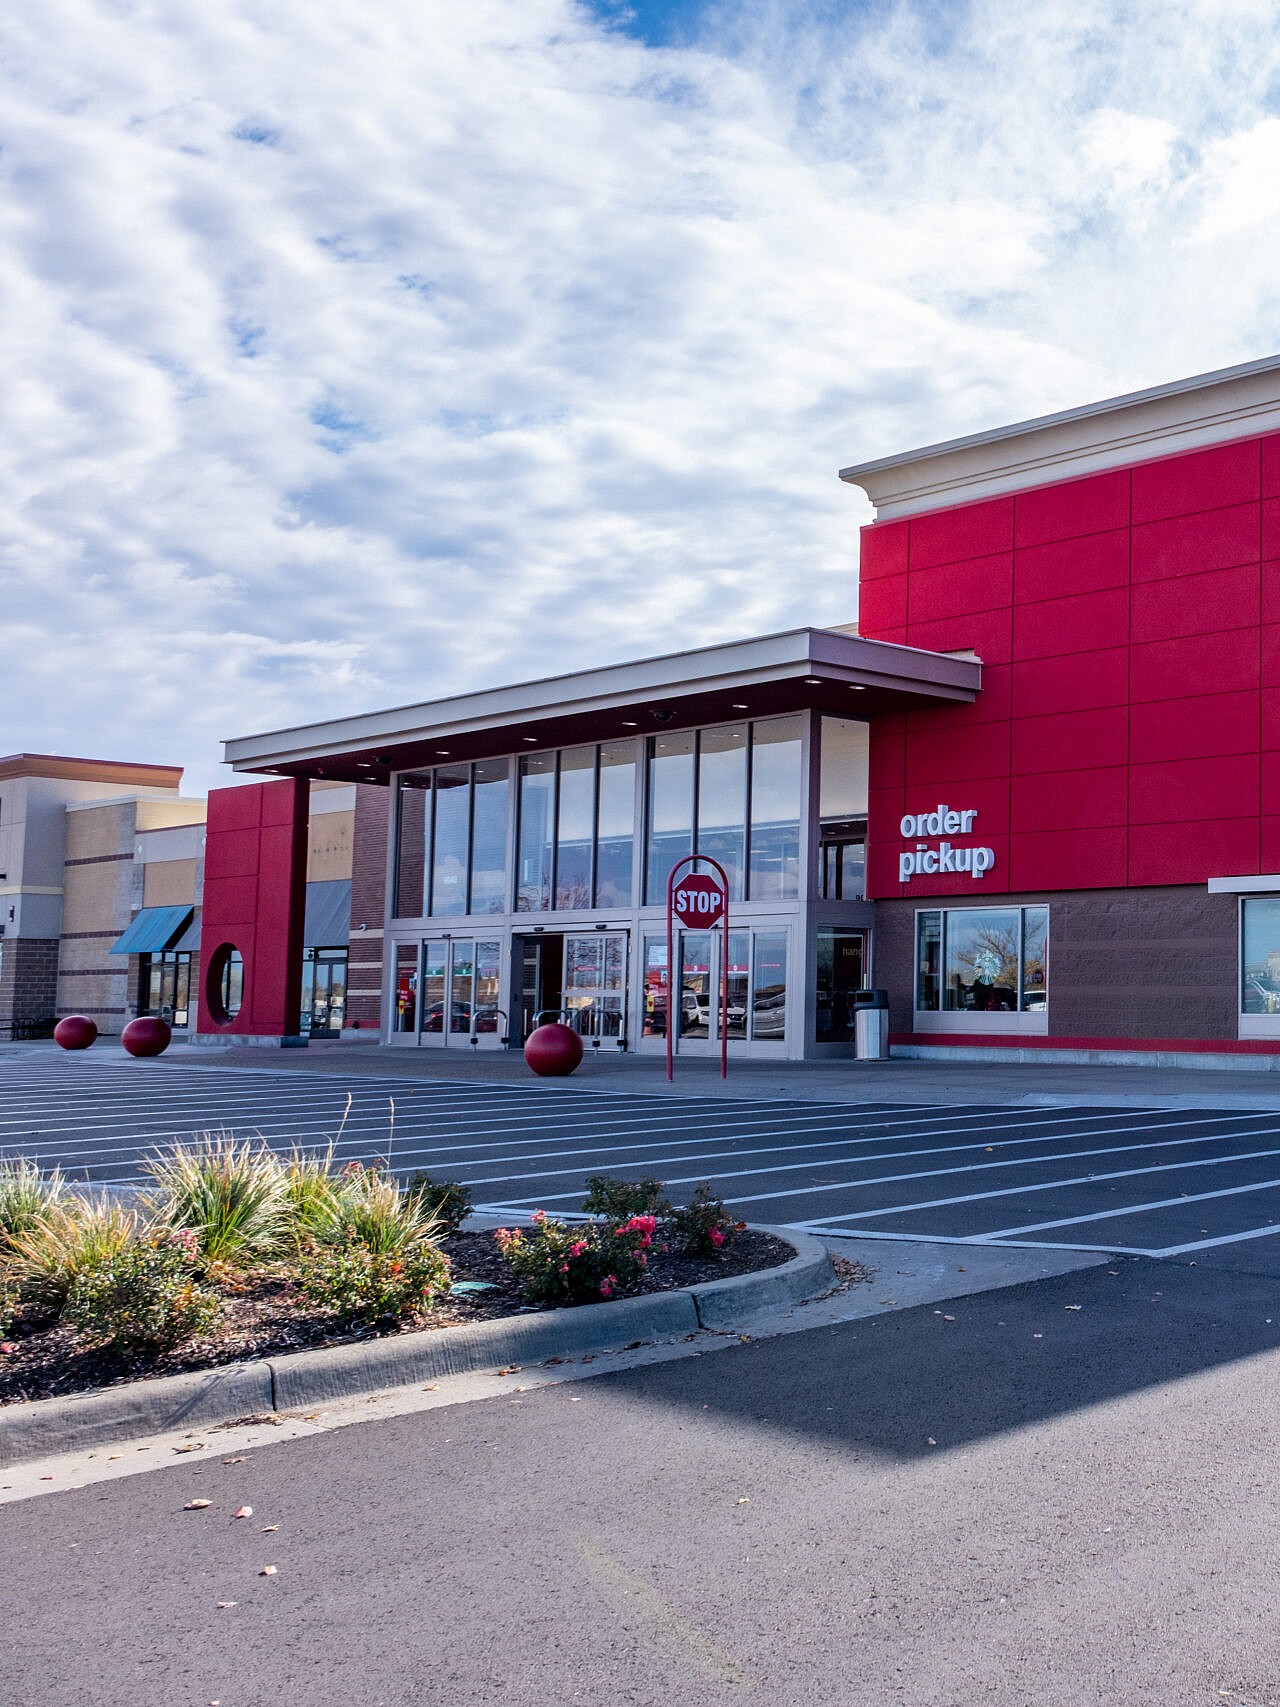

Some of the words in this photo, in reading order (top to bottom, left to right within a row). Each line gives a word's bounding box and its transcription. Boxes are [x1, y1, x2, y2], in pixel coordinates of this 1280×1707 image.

[900, 804, 978, 838] order
[898, 842, 995, 882] pickup
[676, 889, 721, 913] STOP
